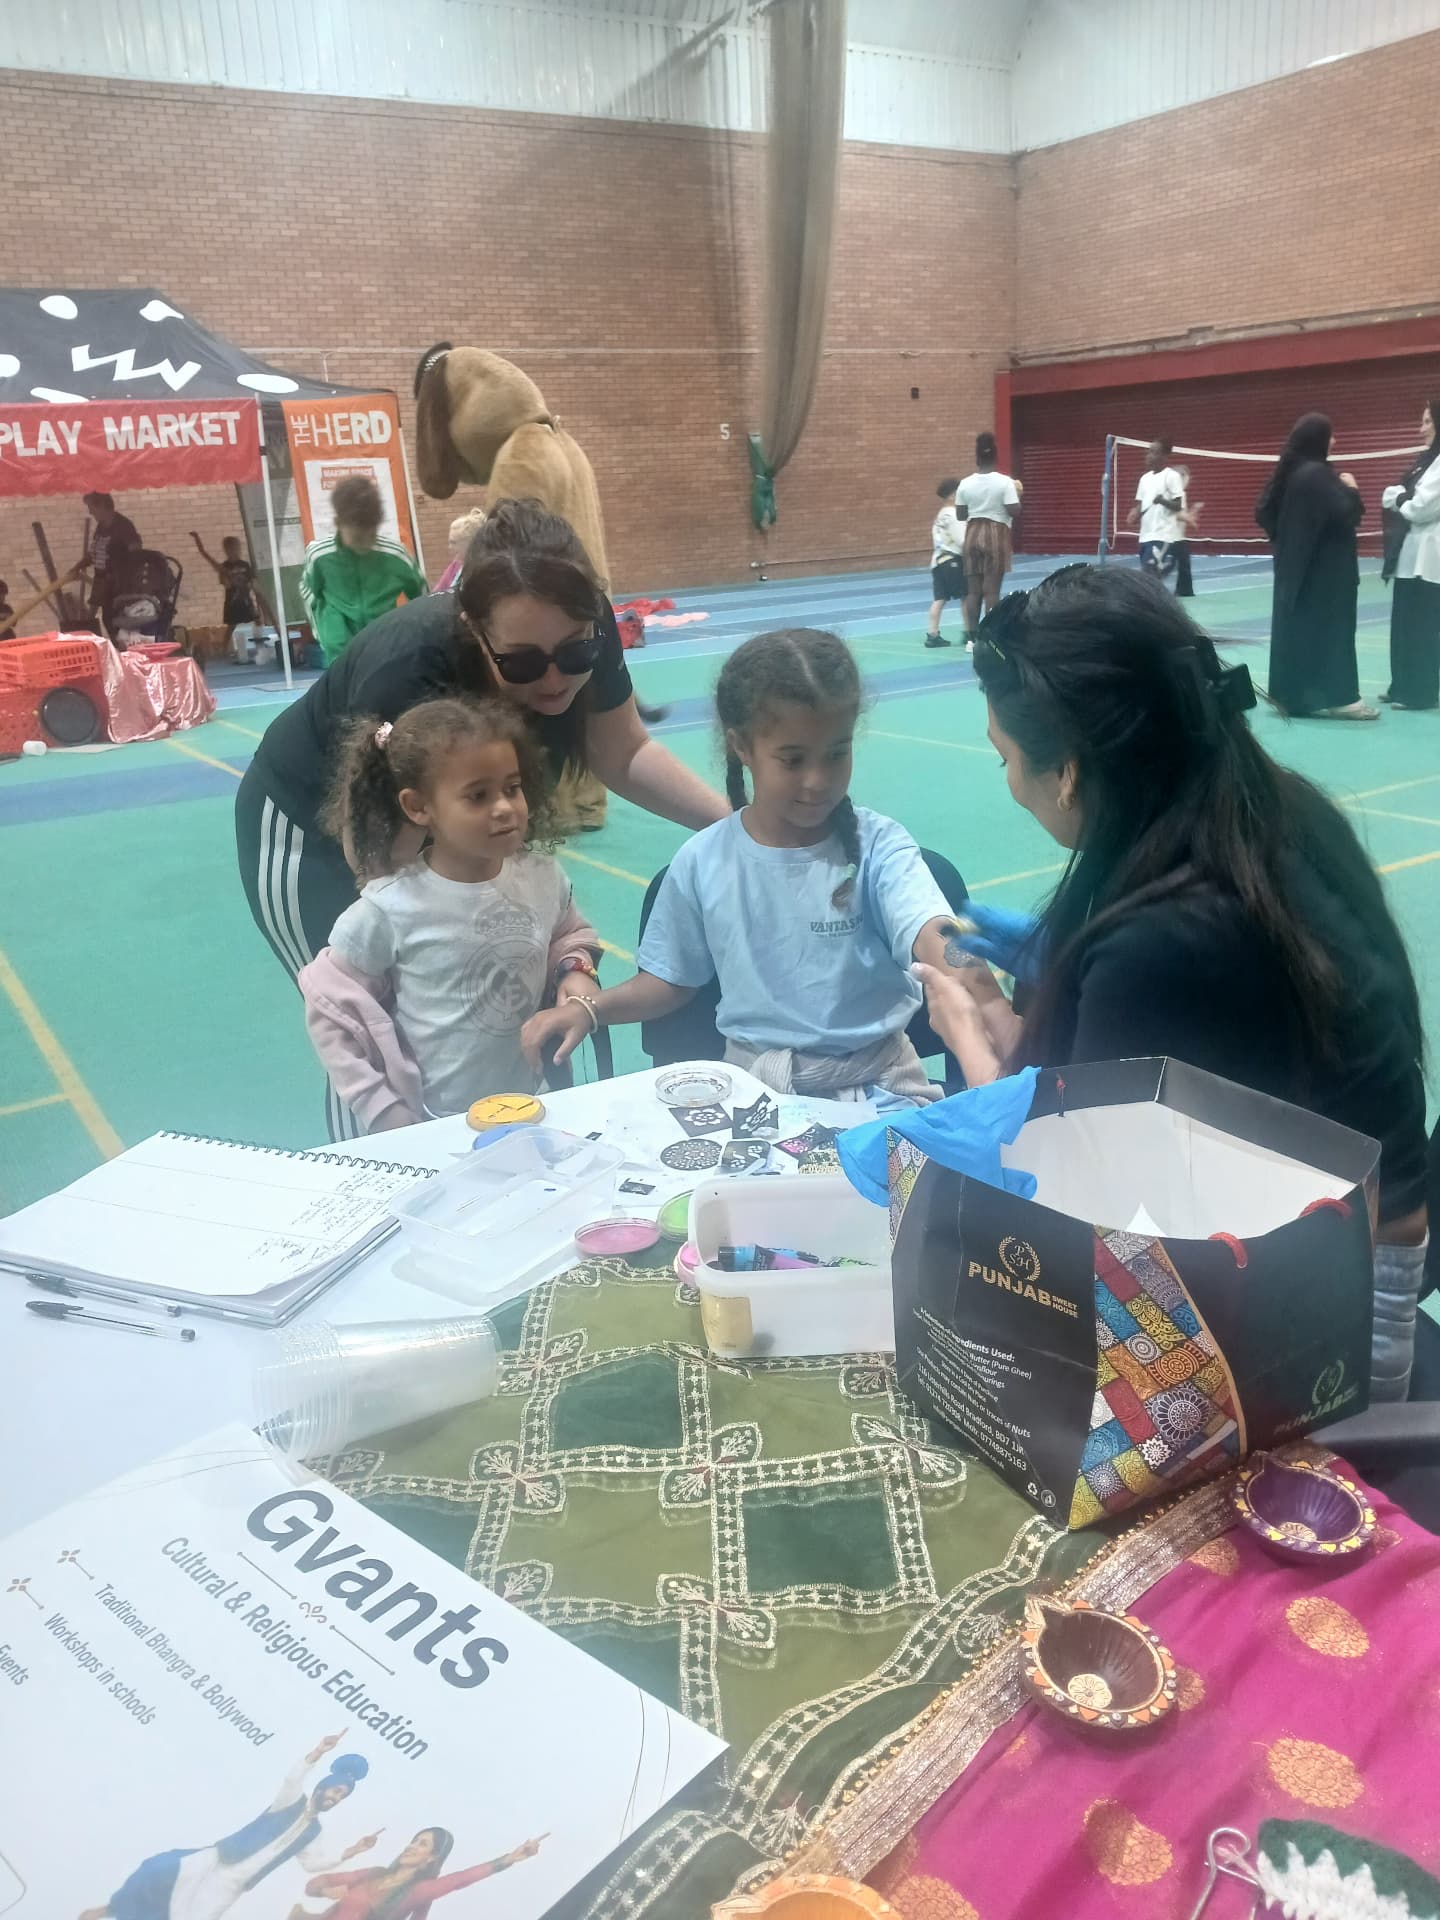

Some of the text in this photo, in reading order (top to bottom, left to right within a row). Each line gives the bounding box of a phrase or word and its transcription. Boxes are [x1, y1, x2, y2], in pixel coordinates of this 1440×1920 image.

[0, 411, 240, 457] PLAY MARKET
[290, 410, 392, 448] THE HERD
[968, 1261, 1078, 1311] PUNJAB SWEET
[1052, 1303, 1079, 1319] HOUSE
[991, 1347, 1016, 1363] Used:
[991, 1359, 1010, 1373] (Pure
[1010, 1366, 1032, 1380] Ghee)
[950, 1393, 965, 1413] Road
[995, 1429, 1010, 1446] BD7
[1011, 1424, 1032, 1438] Nuts
[247, 1489, 509, 1689] Gvants
[44, 1612, 156, 1725] Workshops in schools
[95, 1583, 275, 1746] Traditional Bhangra & Bollywood
[161, 1537, 429, 1760] Cultural & Religious Education
